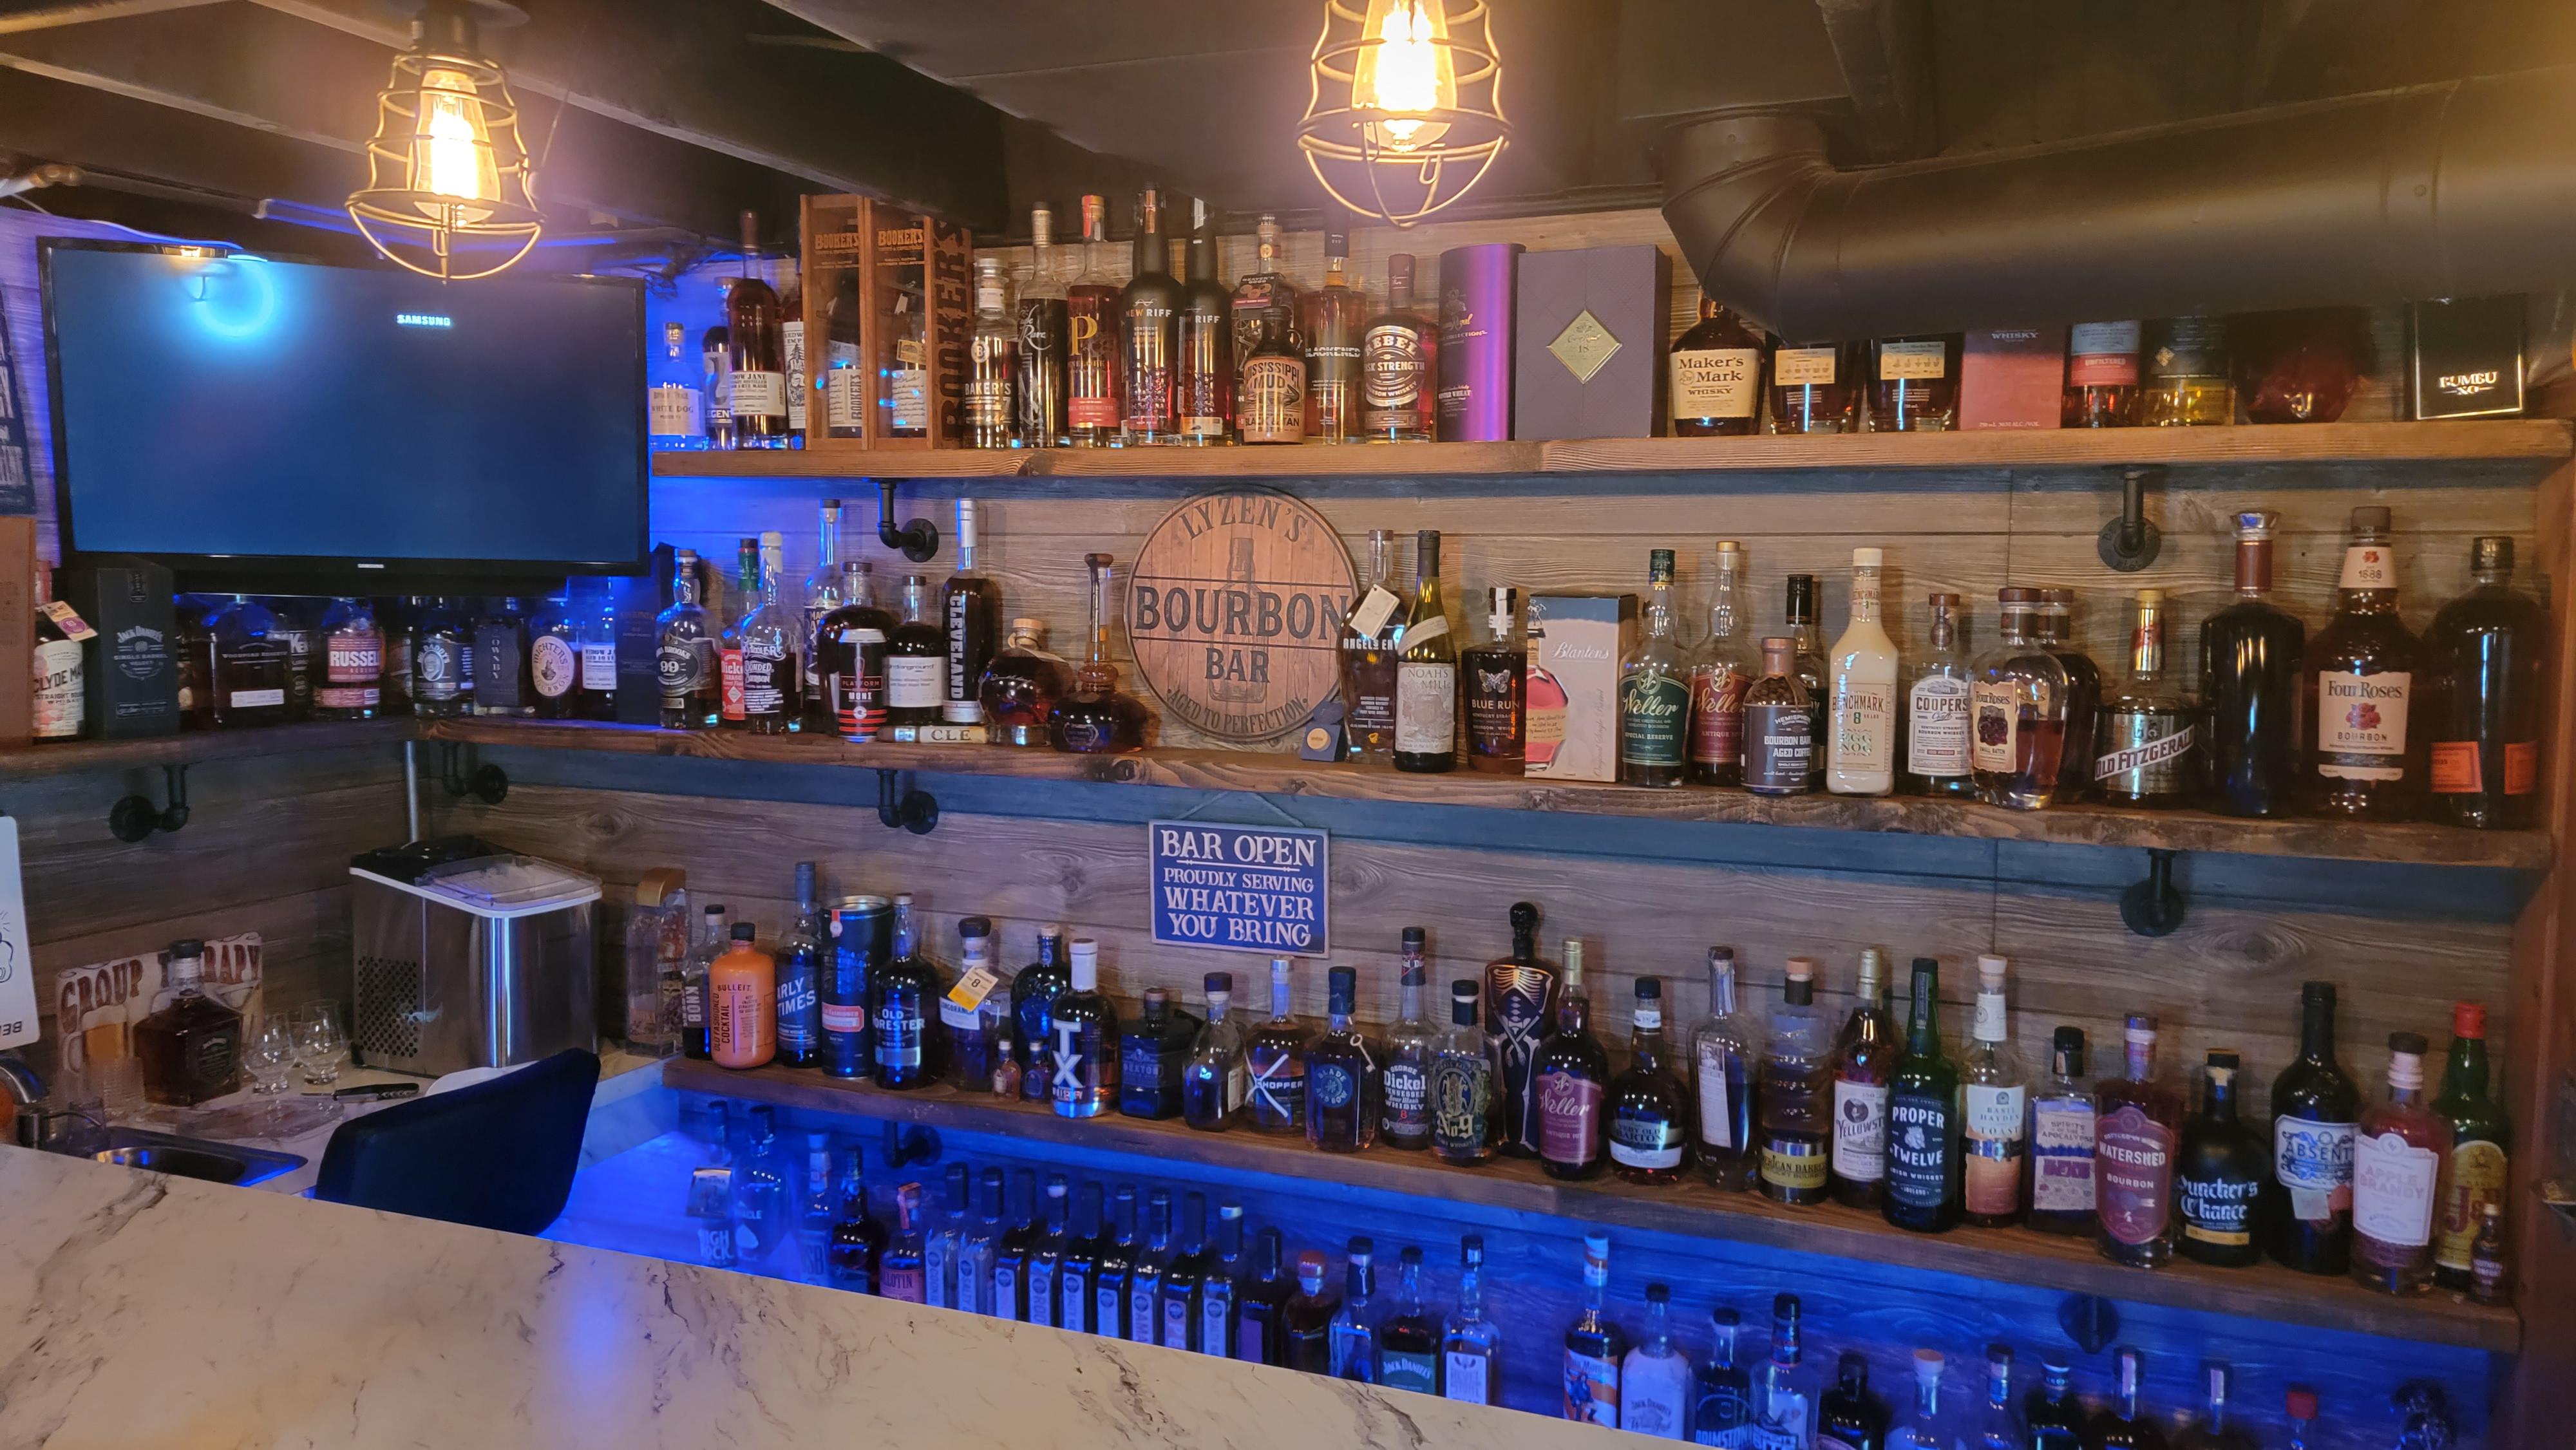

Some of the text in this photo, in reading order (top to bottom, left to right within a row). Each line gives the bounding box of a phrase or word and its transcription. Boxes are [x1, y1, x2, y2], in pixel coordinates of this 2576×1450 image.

[814, 232, 858, 250] BOOKER'S
[878, 228, 924, 247] BOOKER'S
[397, 314, 452, 327] SAMSUNG
[1146, 308, 1173, 317] RIFF
[1195, 315, 1220, 324] RIFF
[1071, 315, 1098, 356] P
[1305, 346, 1361, 357] BLACKENED
[1365, 334, 1419, 357] REBEL
[1377, 361, 1425, 372] STRENGTH
[1678, 355, 1744, 371] Maker's
[1696, 372, 1743, 383] Mark
[2439, 371, 2498, 388] BUMBU
[965, 382, 1011, 396] BAKER'S
[1687, 388, 1733, 396] WHISKY
[676, 404, 694, 413] DOG
[1179, 496, 1309, 543] LYZEN'S
[2358, 569, 2382, 579] 1888
[1135, 585, 1349, 641] BOURBON
[950, 596, 964, 699] CLEVELAND
[1343, 638, 1399, 650] ANGELS ENV
[1551, 641, 1609, 660] Blantons
[659, 661, 679, 673] 99
[721, 661, 743, 674] Dick
[1205, 647, 1270, 683] BAR
[1407, 668, 1449, 679] NOAHS
[33, 670, 68, 693] CLYDE
[2360, 681, 2403, 699] Roses
[1471, 699, 1520, 710] BLUE RUN
[1623, 688, 1679, 717] Weller
[1697, 687, 1745, 714] Welle
[1832, 695, 1885, 712] BENCHMARK
[1989, 692, 2011, 705] Roses
[1167, 689, 1307, 733] AGED TO PERFECTION
[1853, 712, 1861, 724] 8
[931, 729, 972, 741] CLE
[1646, 733, 1674, 741] RESERVE
[1763, 735, 1799, 746] BOURBON
[2337, 731, 2387, 742] BOURBON
[1772, 748, 1793, 758] AGED
[2096, 758, 2115, 778] OLD
[1160, 829, 1317, 867] BAR OPEN
[1164, 867, 1314, 894] PROUDLY SERVING
[1164, 886, 1315, 921] WHATEVER
[1167, 912, 1312, 947] YOU BRING
[717, 984, 752, 992] BULLEIT
[971, 978, 980, 988] 8
[61, 959, 144, 1034] GROUP
[685, 986, 702, 1022] KNOB
[777, 989, 816, 1017] TIMES
[882, 1008, 905, 1019] OLD
[721, 1004, 730, 1044] COCKTAIL
[1317, 1068, 1347, 1083] BLADE
[1390, 1064, 1418, 1076] GEORGE
[1383, 1069, 1426, 1091] Dickel
[1385, 1099, 1425, 1111] WHISKY
[1539, 1088, 1593, 1116] Weller
[1892, 1106, 1945, 1129] PROPER
[1836, 1116, 1886, 1140] YELLOWST
[1980, 1127, 2020, 1135] TOAST
[1892, 1143, 1944, 1167] TWELVE
[2099, 1141, 2166, 1167] WATERSHED
[2286, 1141, 2353, 1160] ABSENT
[2107, 1172, 2154, 1189] BOURBON
[2365, 1163, 2418, 1187] APPLE
[2359, 1174, 2425, 1200] BRANDY
[2180, 1195, 2248, 1221] Chance
